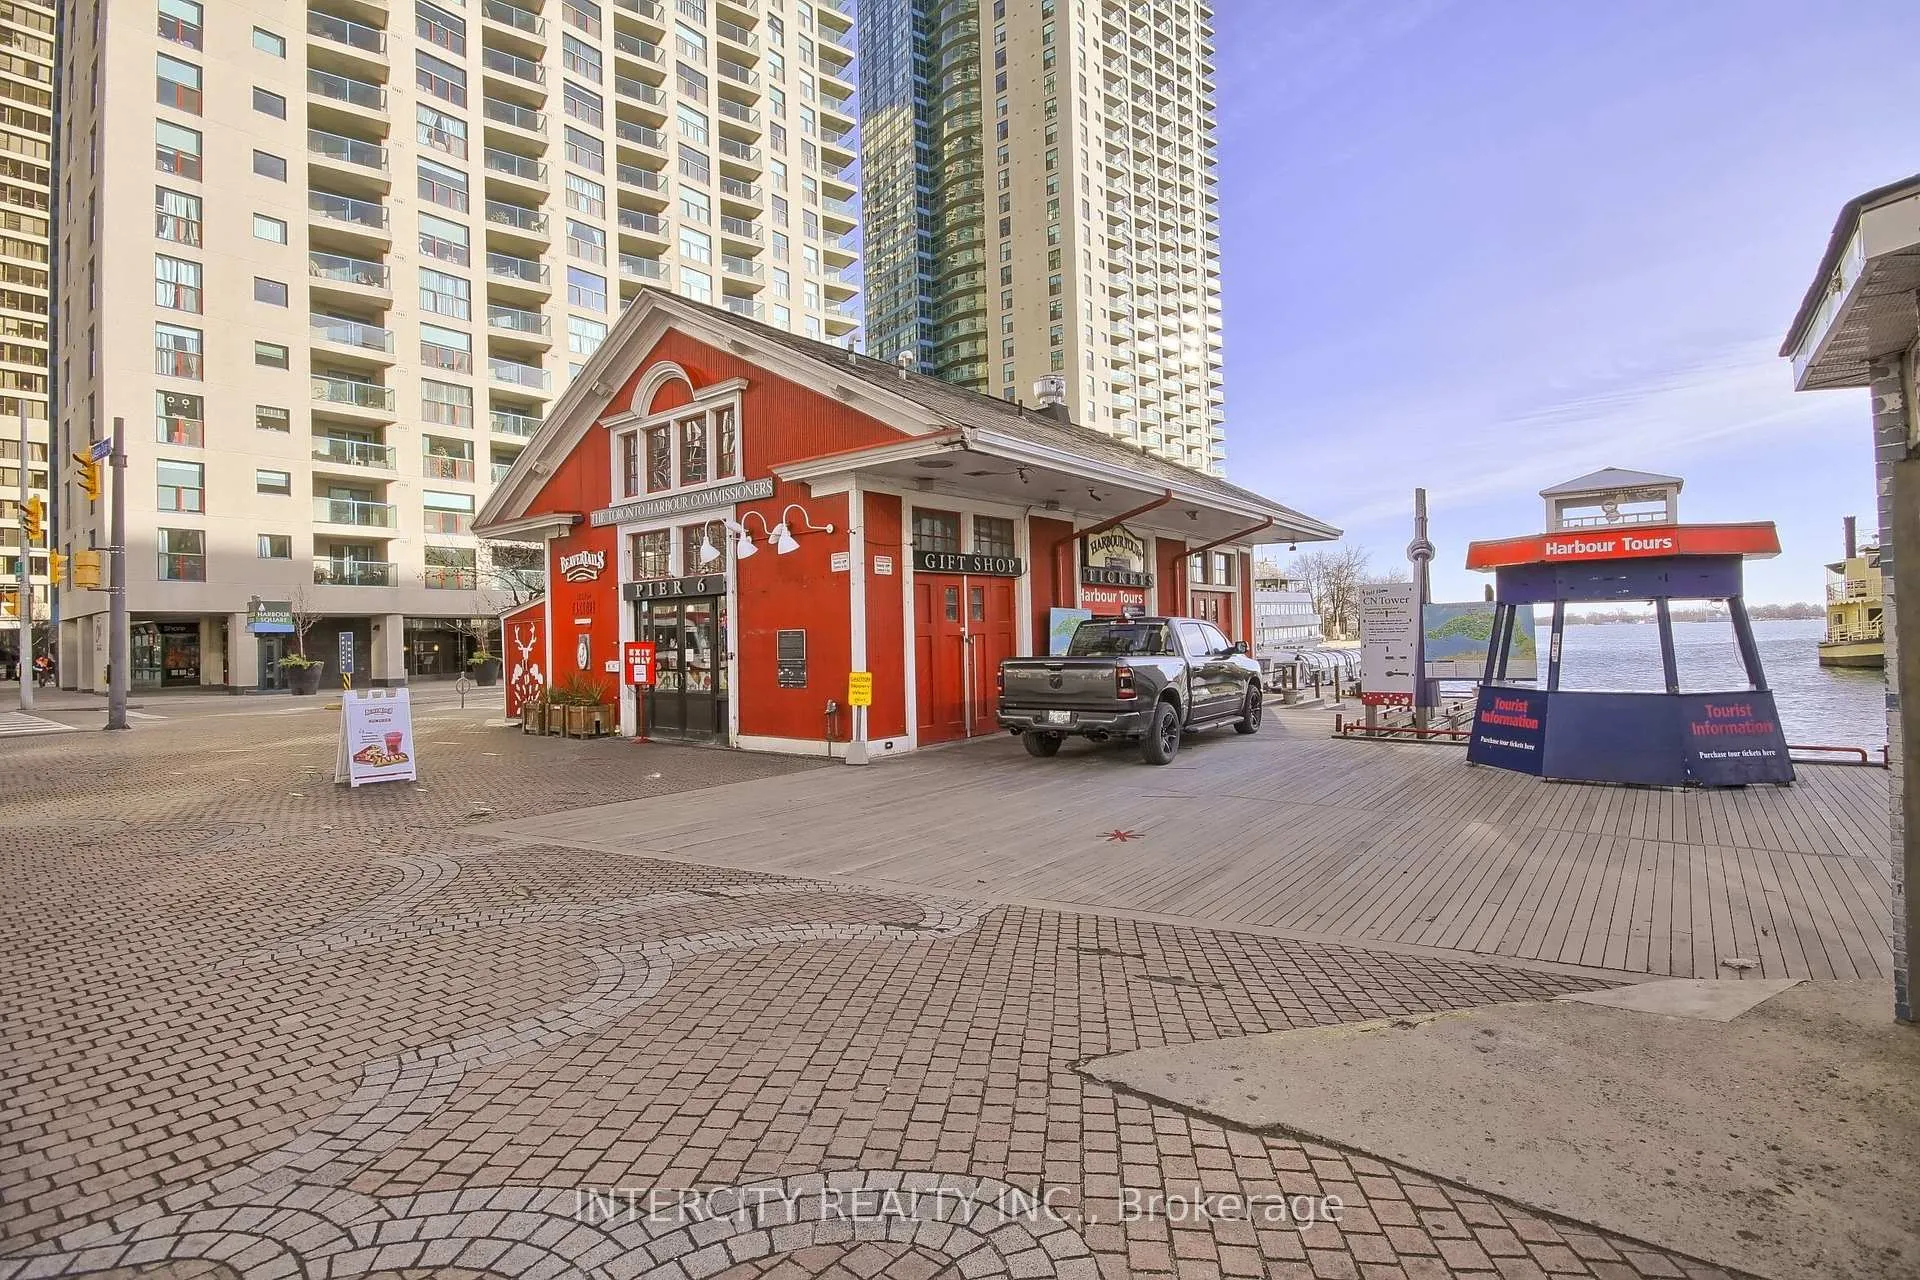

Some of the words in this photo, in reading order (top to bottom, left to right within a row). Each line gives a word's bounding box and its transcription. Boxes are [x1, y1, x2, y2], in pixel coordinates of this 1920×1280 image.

[608, 504, 646, 522] TORONTO
[648, 496, 688, 515] HARBOUR
[690, 480, 773, 506] COMMISSIONERS
[1090, 534, 1124, 556] HARBOUR
[1545, 540, 1616, 556] Harbour
[1621, 537, 1673, 551] Tours
[925, 553, 966, 570] GIFT
[974, 556, 1015, 573] SHOP
[1087, 569, 1154, 586] TICKETS
[635, 580, 683, 598] PIER
[697, 577, 706, 593] 6
[1080, 587, 1117, 603] Harbour
[1119, 590, 1143, 604] Tours
[1363, 597, 1378, 605] CN
[1380, 596, 1410, 605] Tower
[629, 648, 651, 656] EXIT
[629, 656, 651, 664] ONLY
[1495, 696, 1528, 711] Tourist
[1704, 703, 1752, 718] Tourist
[1481, 710, 1539, 729] Information
[1692, 719, 1774, 736] Information
[1480, 735, 1499, 745] Purchase
[1499, 738, 1509, 746] tour
[1510, 740, 1524, 749] tickets
[1525, 743, 1535, 751] here
[1699, 750, 1727, 759] Purchase
[1728, 750, 1740, 758] tour
[1741, 749, 1762, 757] tickets
[1762, 748, 1776, 757] here
